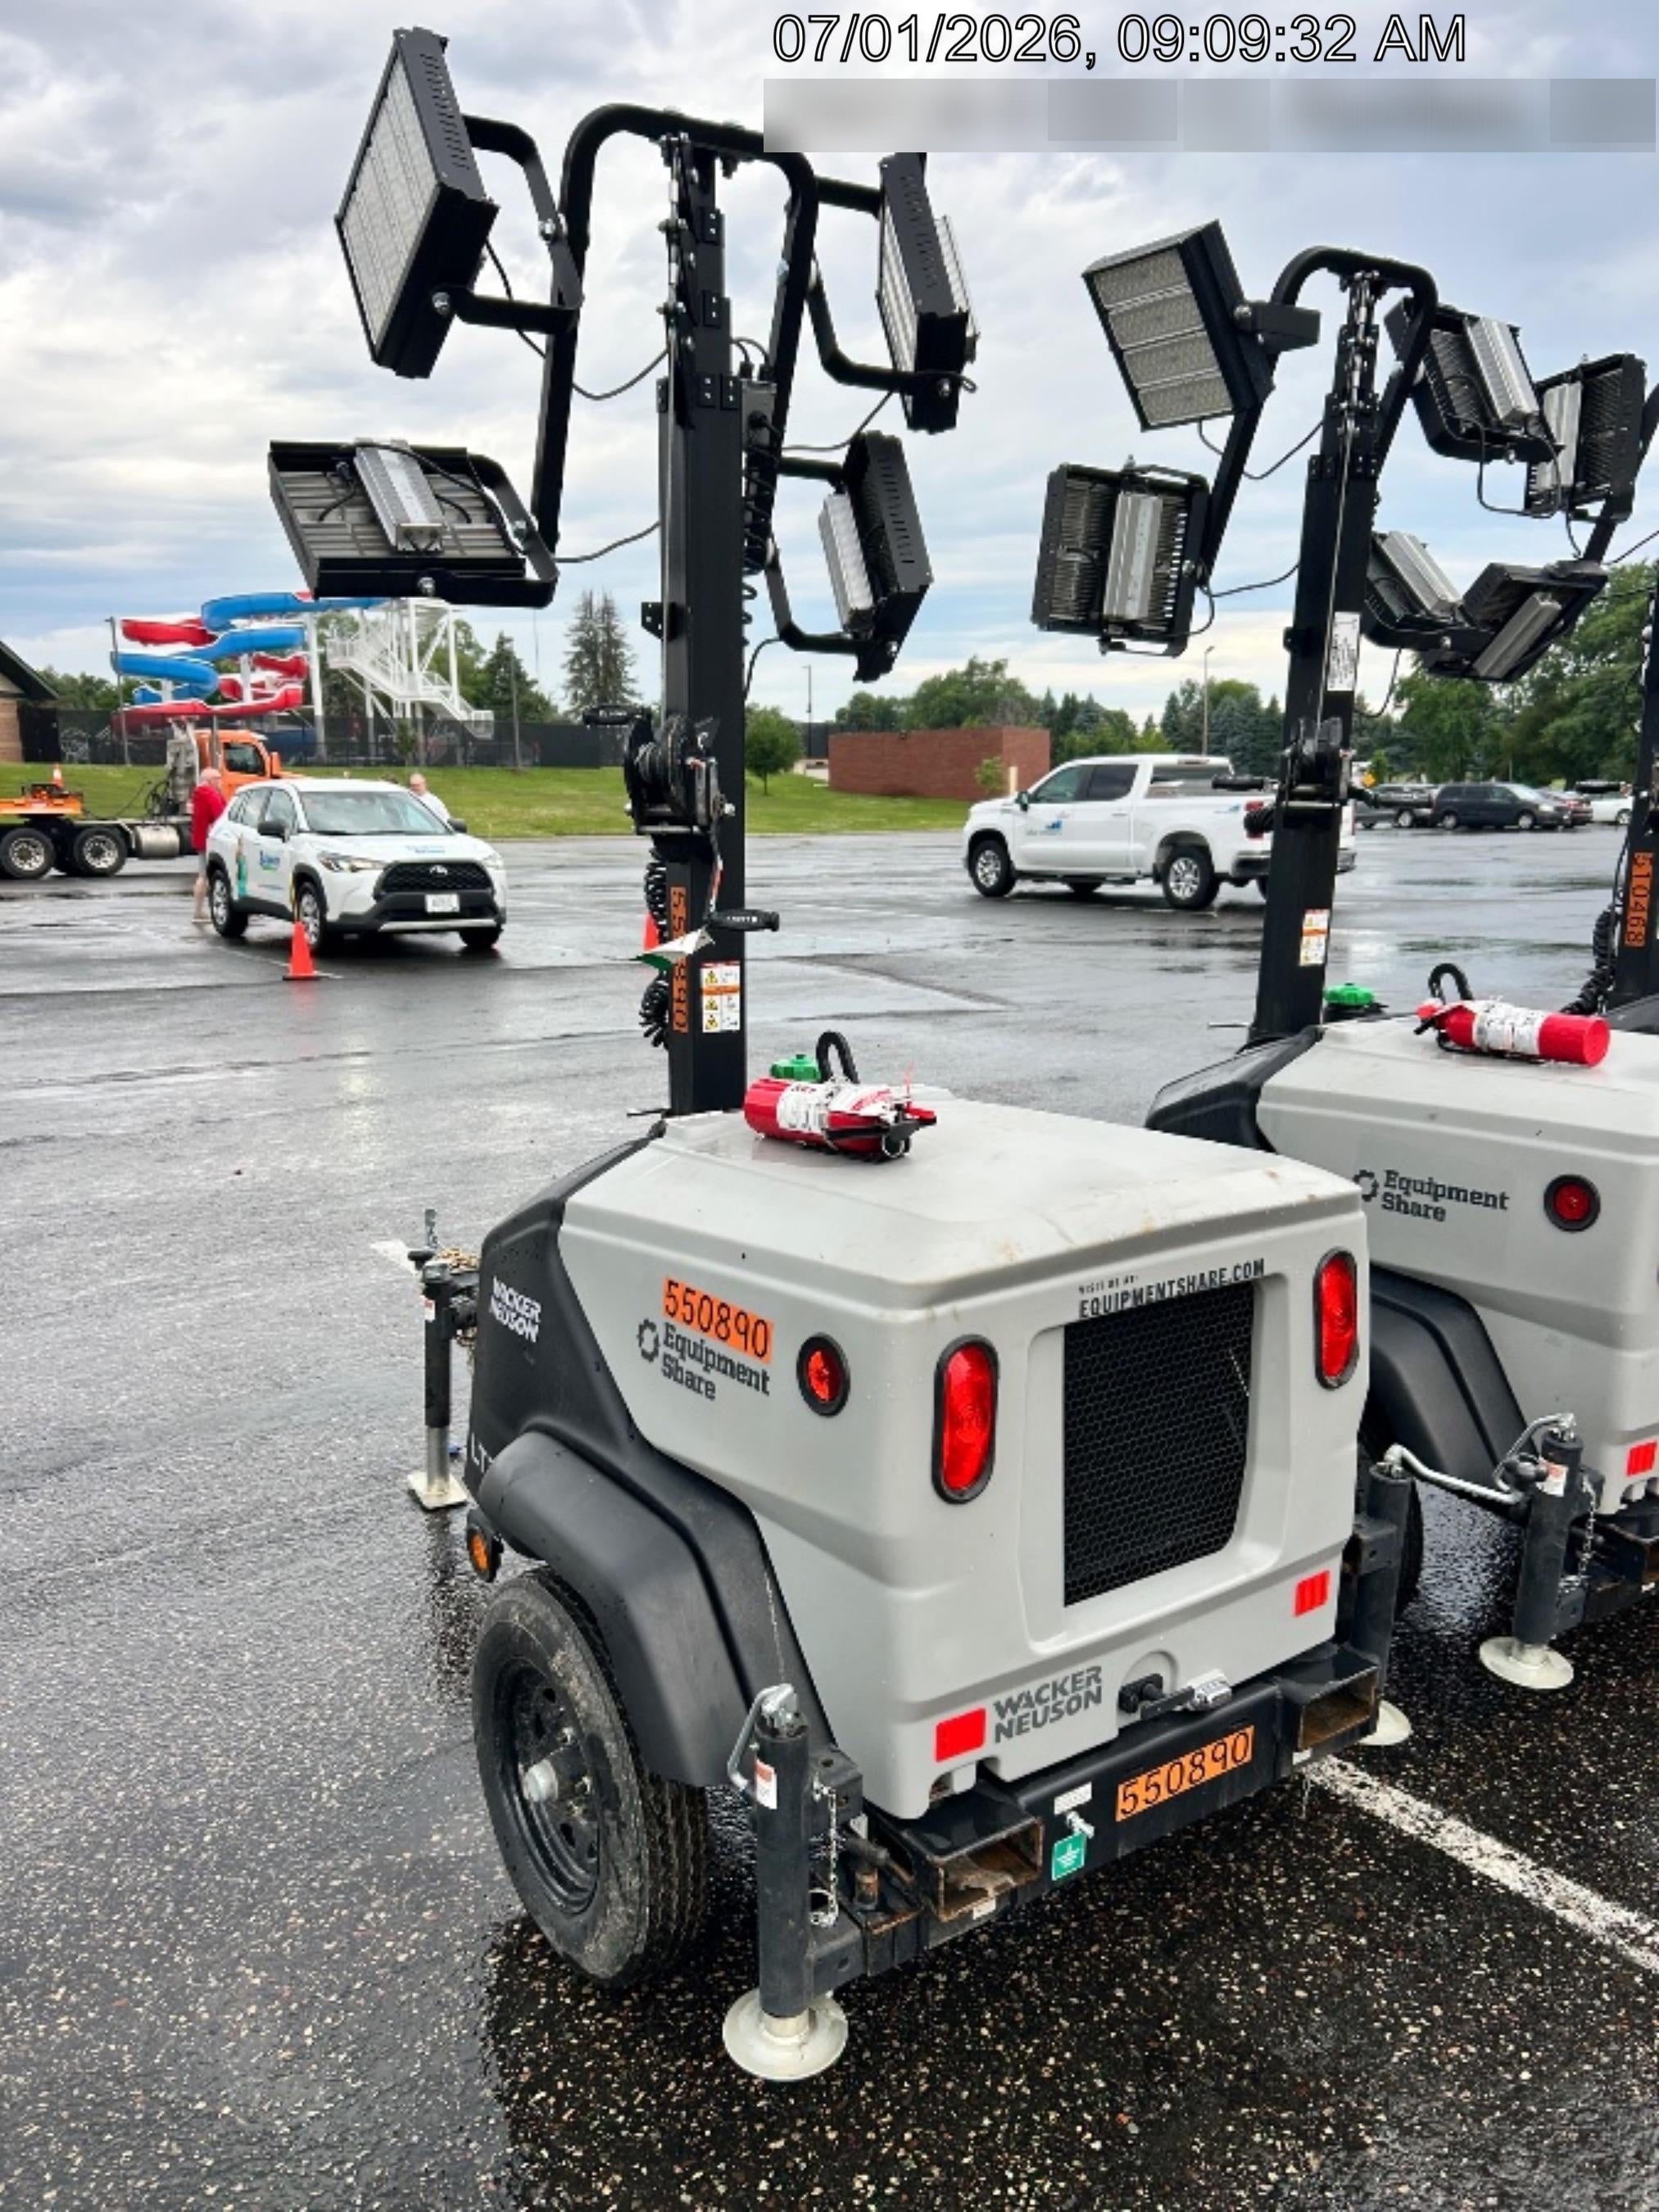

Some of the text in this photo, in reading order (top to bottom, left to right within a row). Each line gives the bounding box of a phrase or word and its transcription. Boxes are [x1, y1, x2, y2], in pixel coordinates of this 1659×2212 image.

[1626, 854, 1652, 944] 510468
[1380, 1191, 1447, 1222] Share
[1383, 1168, 1510, 1212] Equipment
[492, 1275, 542, 1323] WACKER
[1079, 1258, 1265, 1319] EQUIPMENTSHARE.COM
[489, 1294, 539, 1343] NEUSON
[664, 1279, 769, 1359] 550890
[661, 1352, 716, 1401] Share
[662, 1321, 770, 1396] Equipment
[993, 1665, 1102, 1720] WACKER
[994, 1686, 1102, 1743] NEUSON
[1119, 1730, 1250, 1816] 550890
